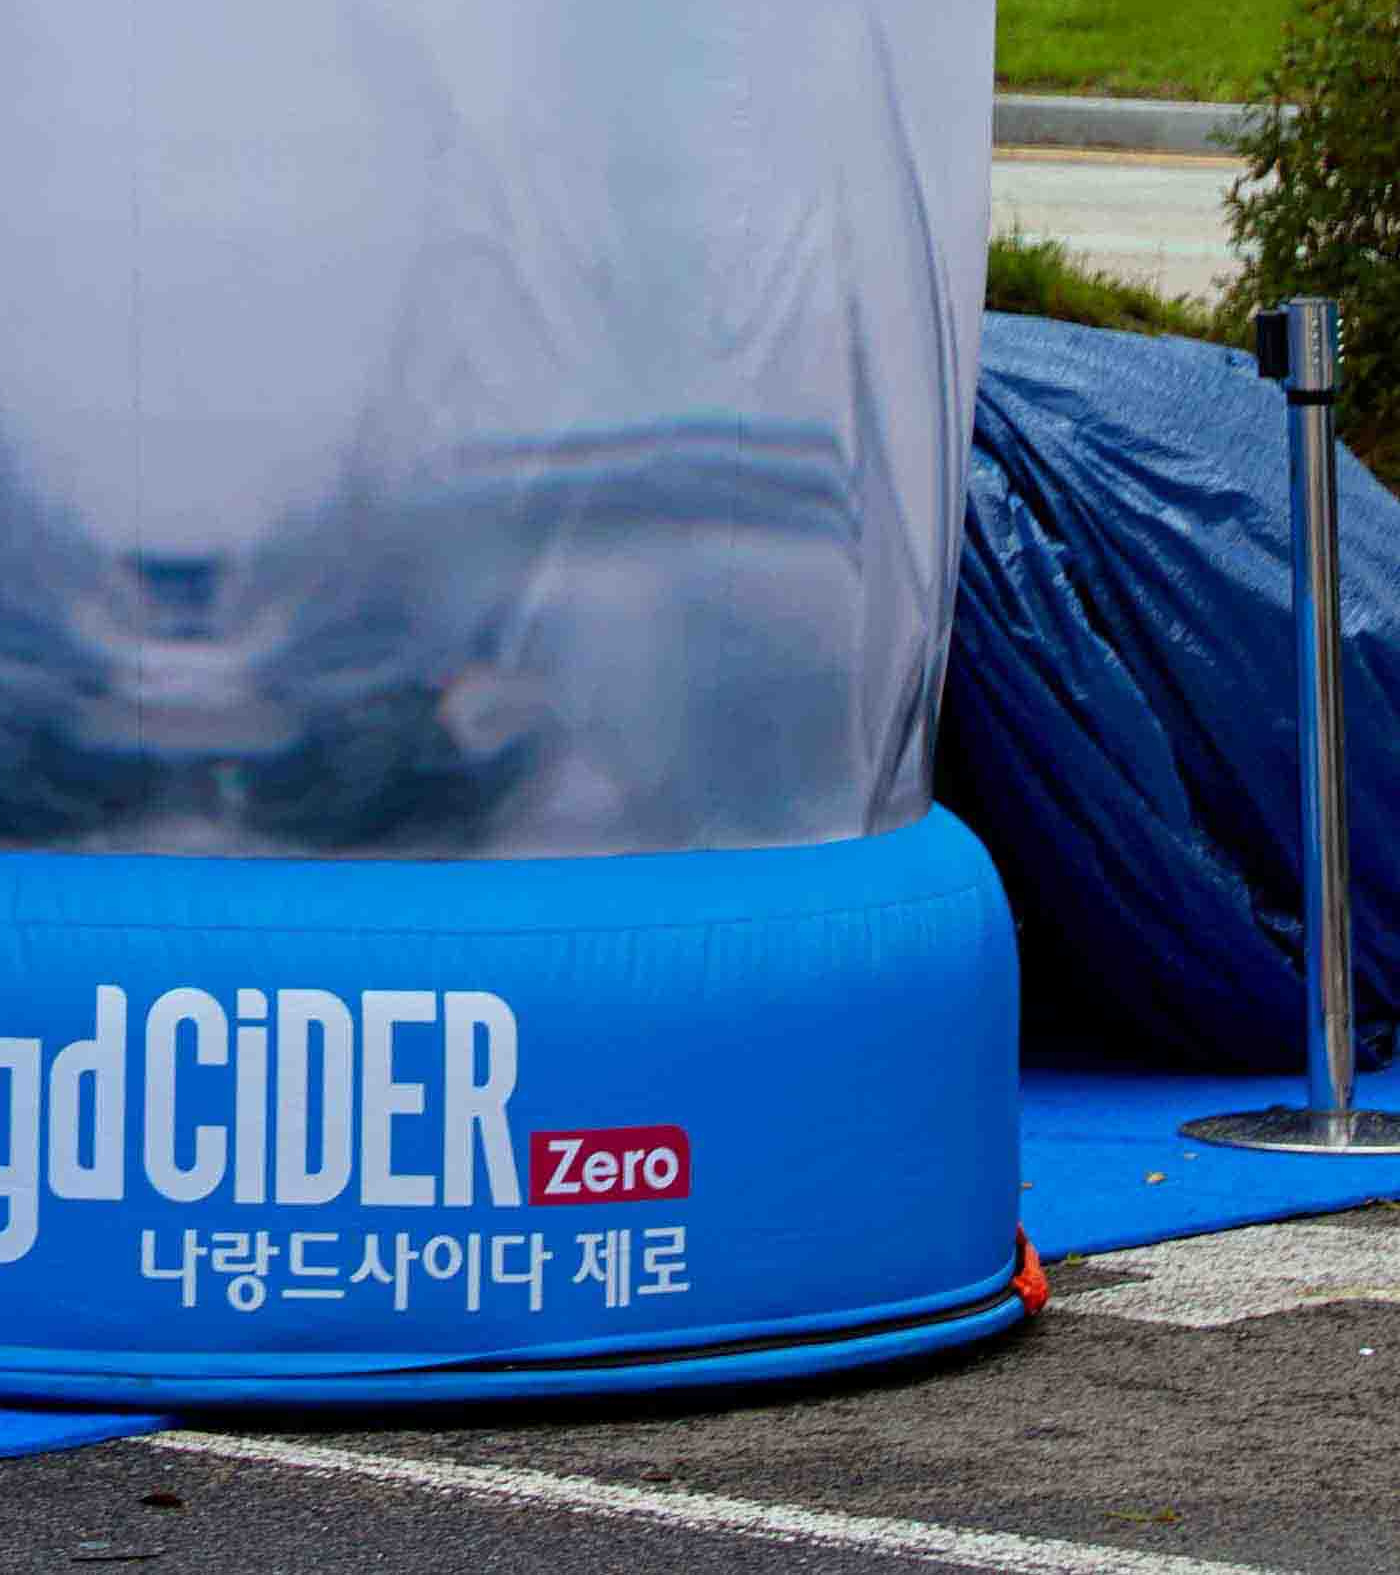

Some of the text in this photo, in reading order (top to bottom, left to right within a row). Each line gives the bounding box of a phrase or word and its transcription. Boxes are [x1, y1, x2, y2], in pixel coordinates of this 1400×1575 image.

[546, 1138, 678, 1197] Zero
[140, 1226, 690, 1313] 나랑드사이다 제로
